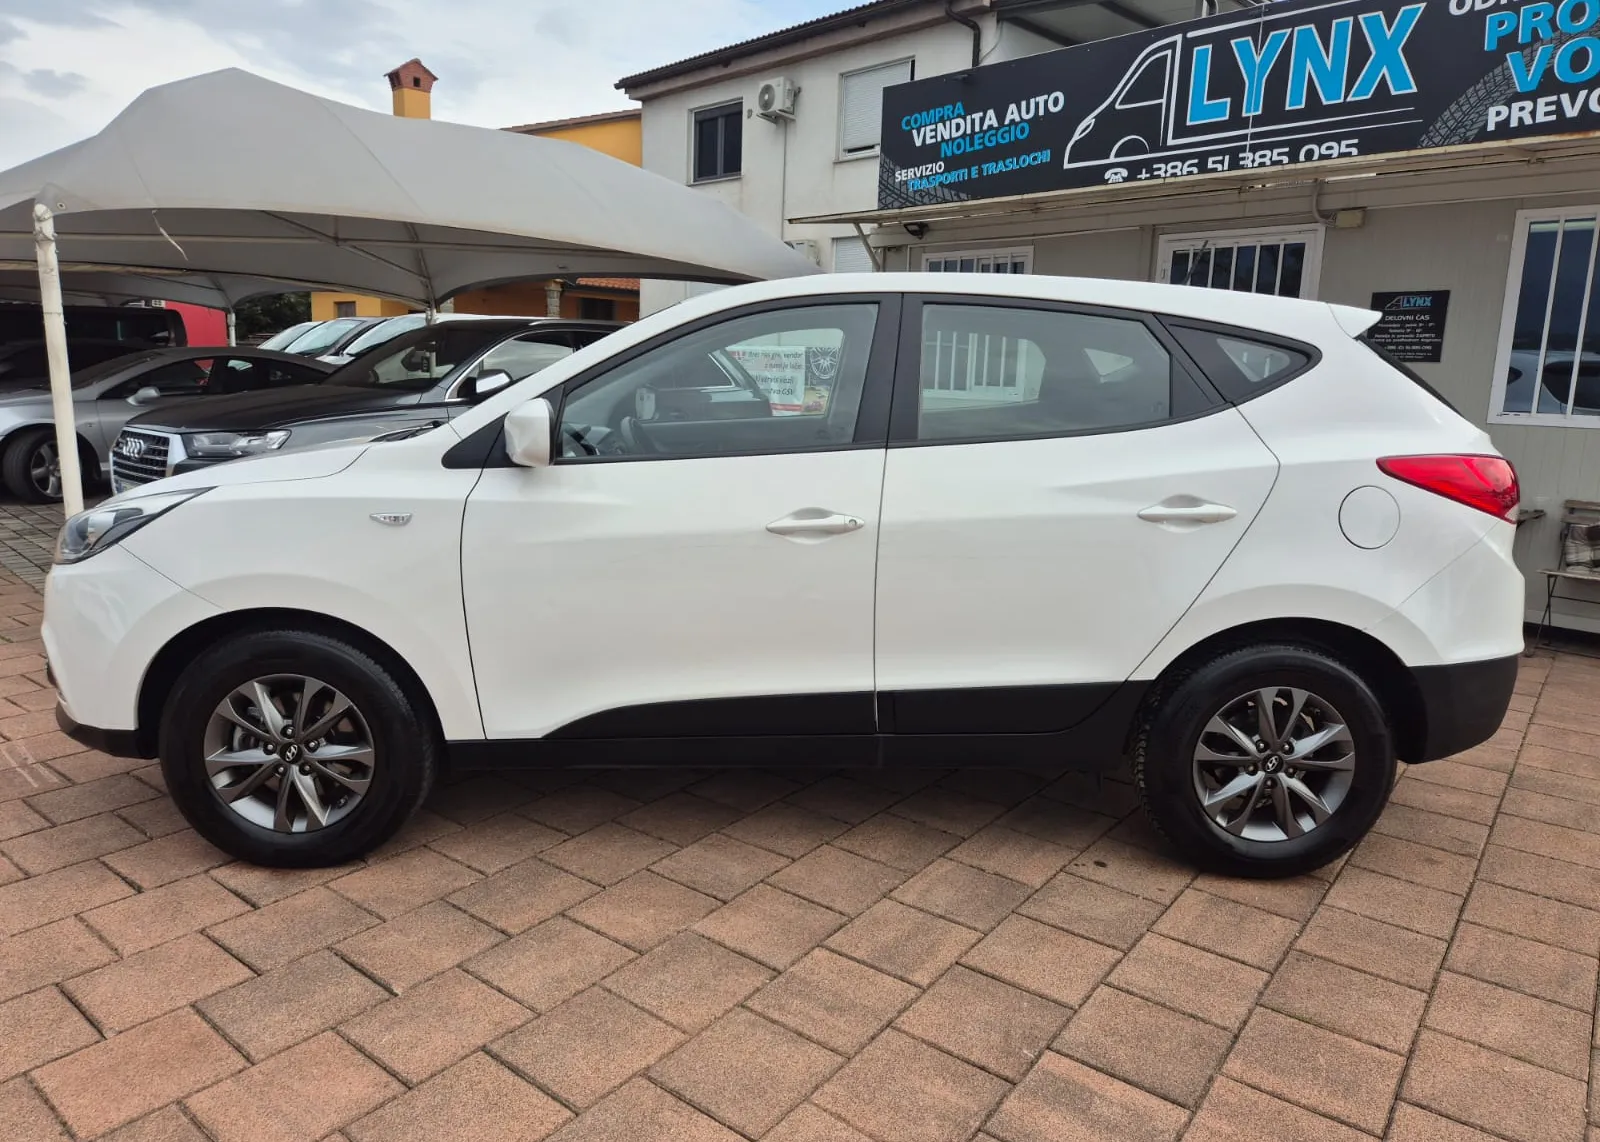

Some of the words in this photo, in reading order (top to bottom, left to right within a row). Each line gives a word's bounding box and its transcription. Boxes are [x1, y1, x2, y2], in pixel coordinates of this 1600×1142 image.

[1186, 2, 1427, 126] LYNX
[901, 101, 965, 131] COMPRA
[912, 108, 999, 147] VENDITA
[1004, 91, 1065, 125] AUTO
[941, 122, 1030, 158] NOLEGGIO
[895, 161, 945, 182] SERVIZIO
[907, 168, 968, 191] TRASPORTI
[971, 166, 979, 178] E
[981, 148, 1051, 176] TRASLOCHI
[1403, 296, 1432, 307] LYNX
